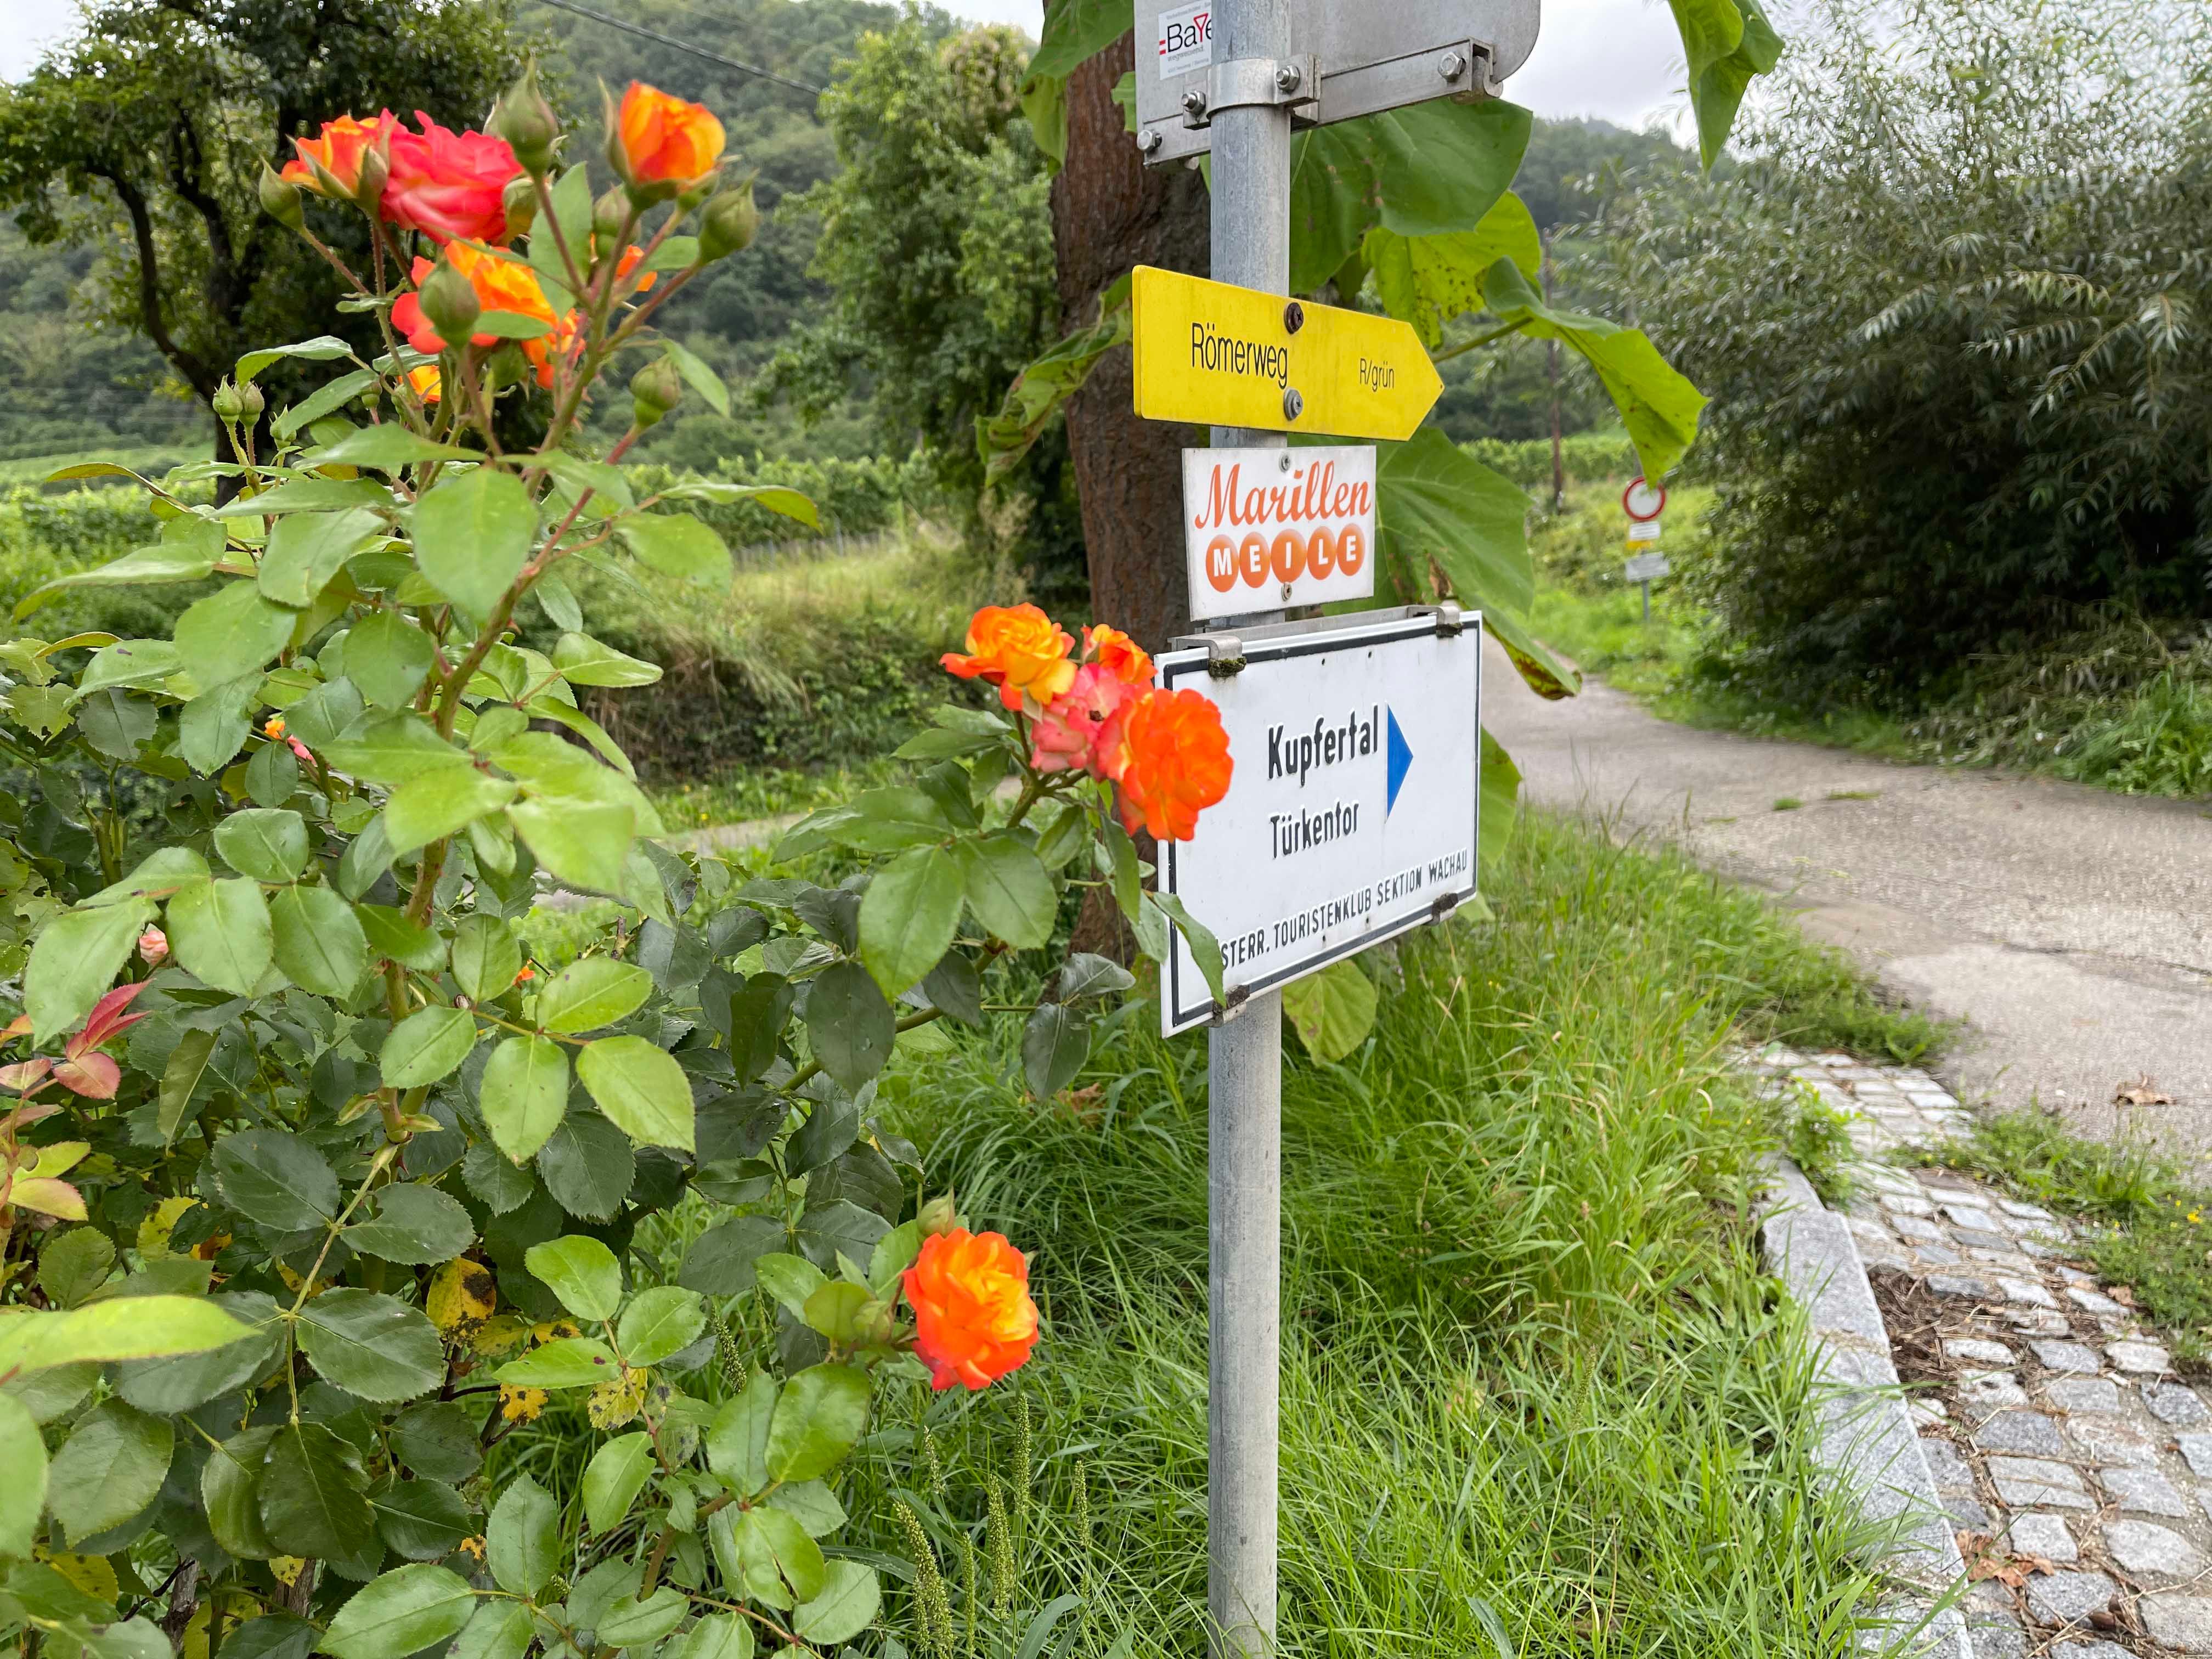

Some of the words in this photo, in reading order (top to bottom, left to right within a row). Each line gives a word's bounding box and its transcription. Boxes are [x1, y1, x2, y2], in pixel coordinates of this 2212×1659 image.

[1192, 321, 1288, 390] Römerweg
[1359, 358, 1395, 392] R/grün
[1194, 460, 1372, 529] Marillen
[1212, 534, 1358, 578] MEILE
[1267, 703, 1379, 787] Kupfertal
[1269, 800, 1359, 859] Türkentor
[1220, 928, 1270, 970] STERR.
[1273, 887, 1372, 949] TOURISTENKLUB
[1376, 865, 1423, 906] SEKTION
[1428, 848, 1468, 885] WACHAU
